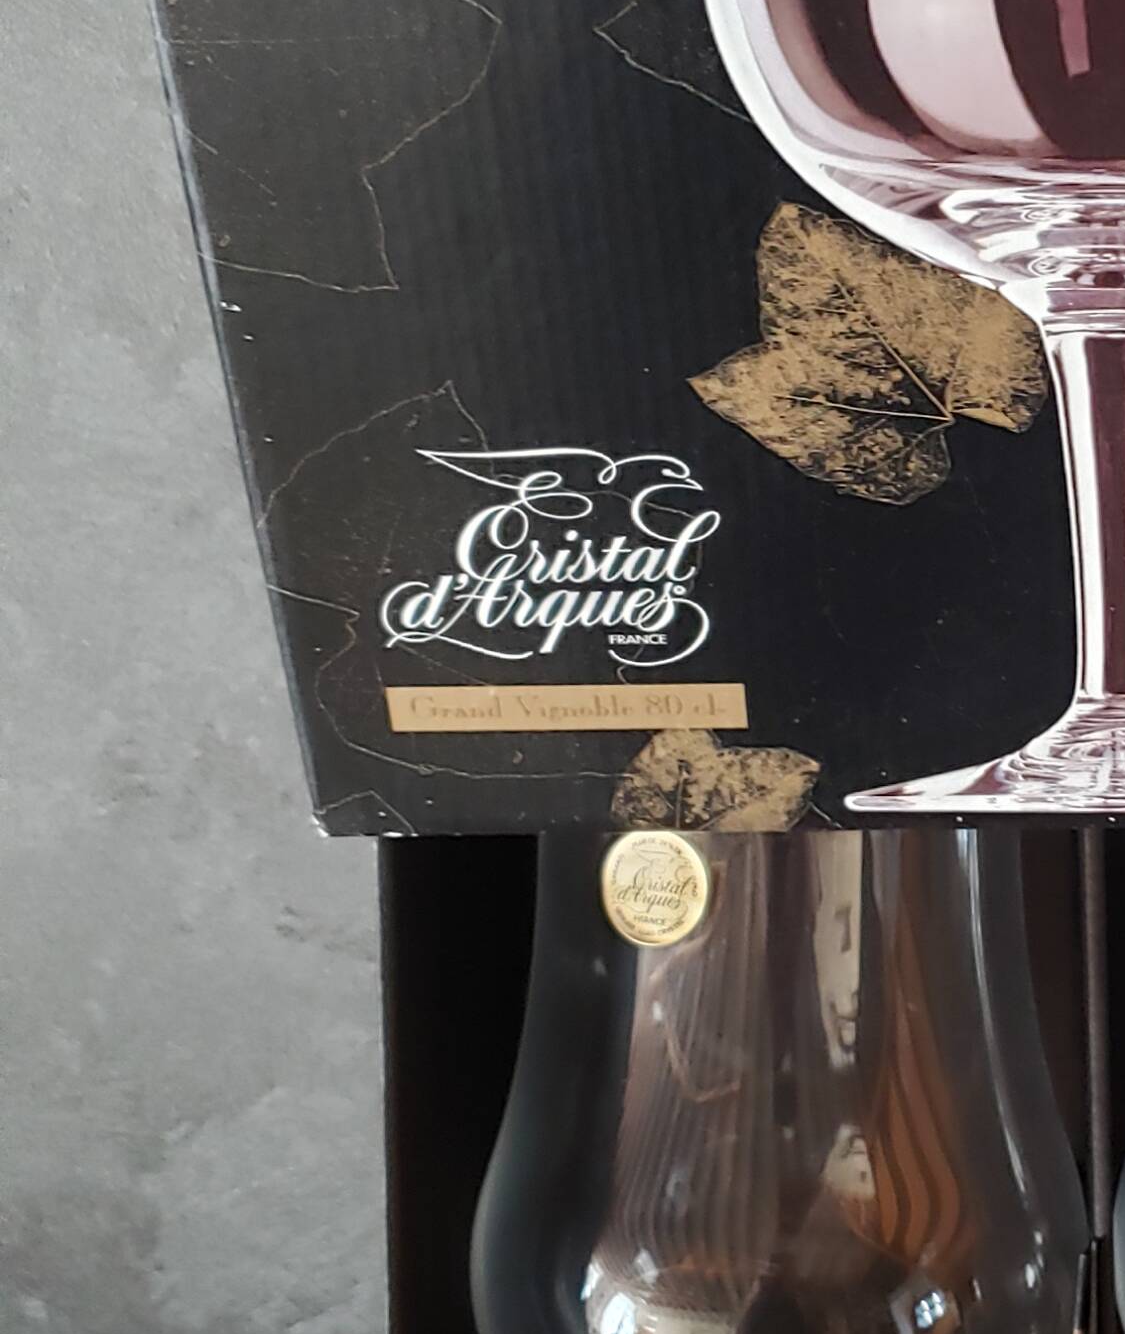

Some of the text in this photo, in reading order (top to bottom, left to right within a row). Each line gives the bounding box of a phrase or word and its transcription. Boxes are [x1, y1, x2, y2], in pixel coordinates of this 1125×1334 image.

[457, 492, 720, 583] Cristal
[608, 633, 668, 646] FRANCE
[410, 695, 503, 719] Grand
[515, 693, 633, 722] Vignoble
[645, 693, 683, 717] 80
